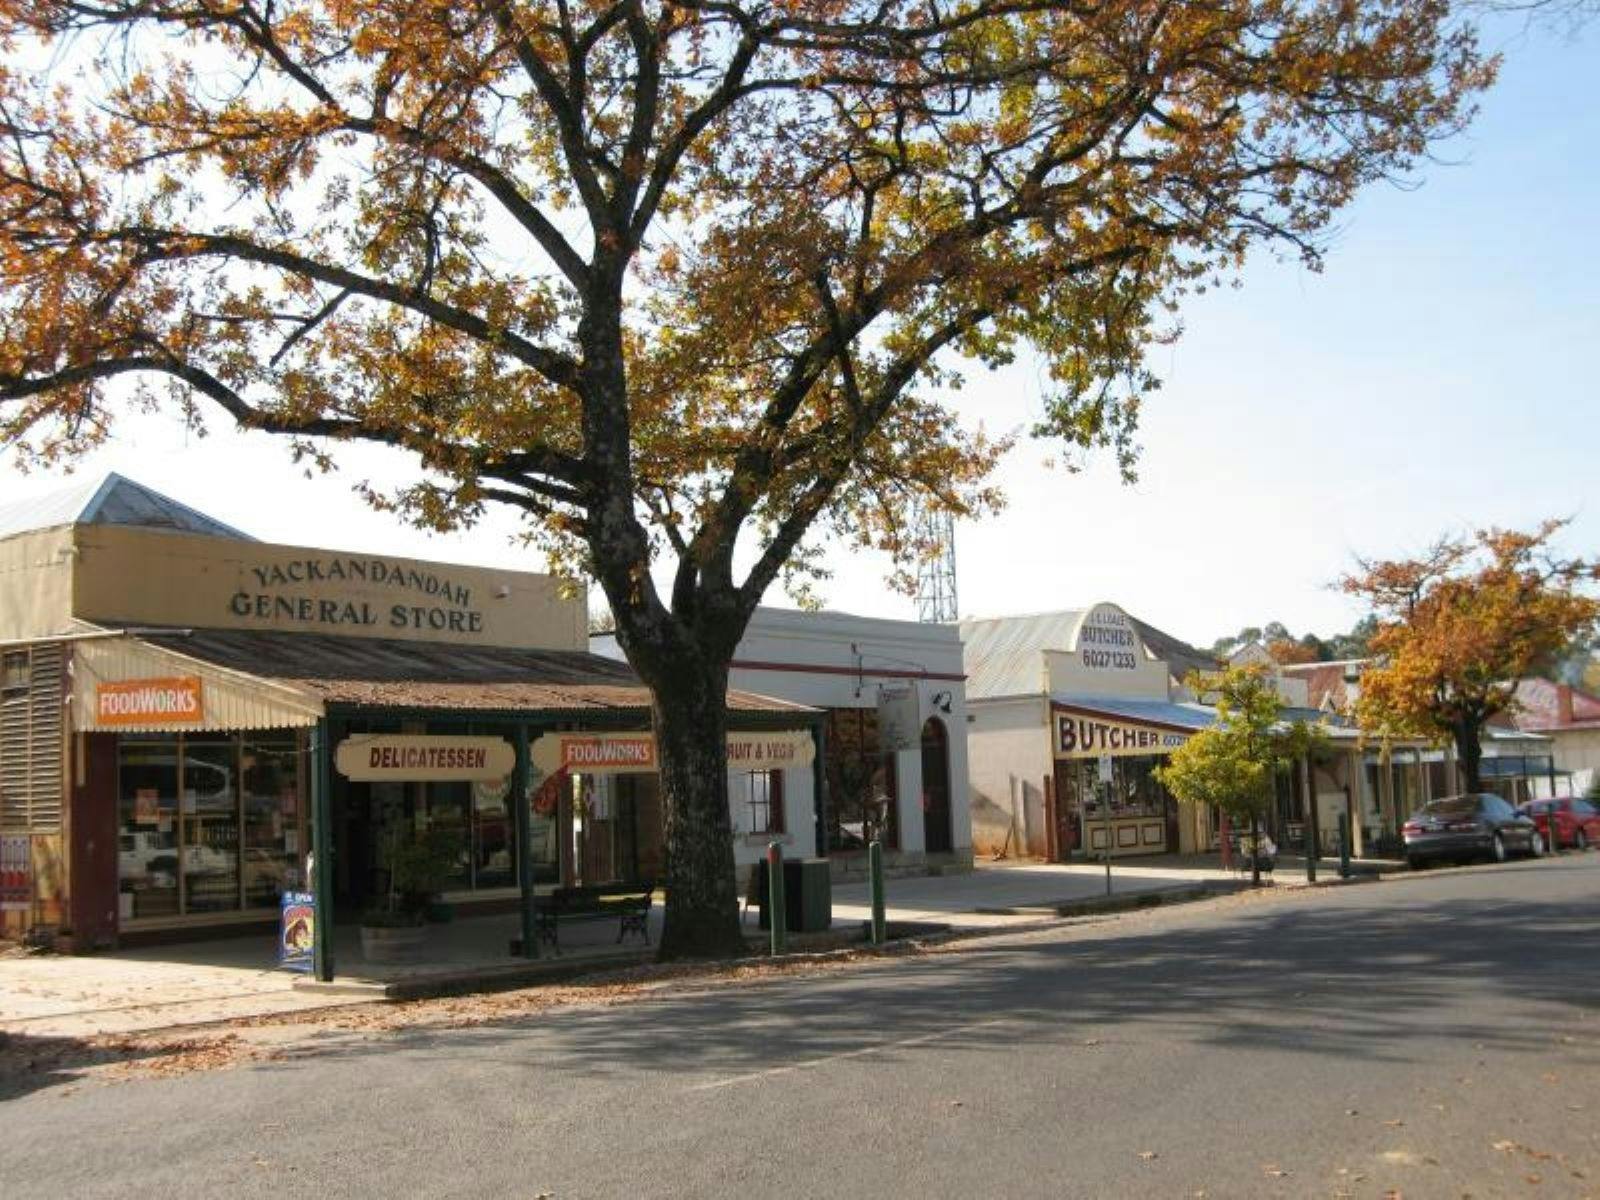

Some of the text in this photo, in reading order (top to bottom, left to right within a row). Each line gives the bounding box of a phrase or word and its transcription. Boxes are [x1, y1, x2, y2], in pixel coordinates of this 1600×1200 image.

[253, 558, 471, 607] YACKANDANDAH
[231, 592, 483, 632] GENERAL STORE
[1081, 625, 1135, 647] BUTCHER
[101, 686, 197, 718] FOODWORKS
[1059, 716, 1160, 752] BUTCHER
[369, 746, 488, 769] DELICATESSEN
[567, 742, 650, 763] FOODWORKS
[726, 742, 752, 760] RUIT
